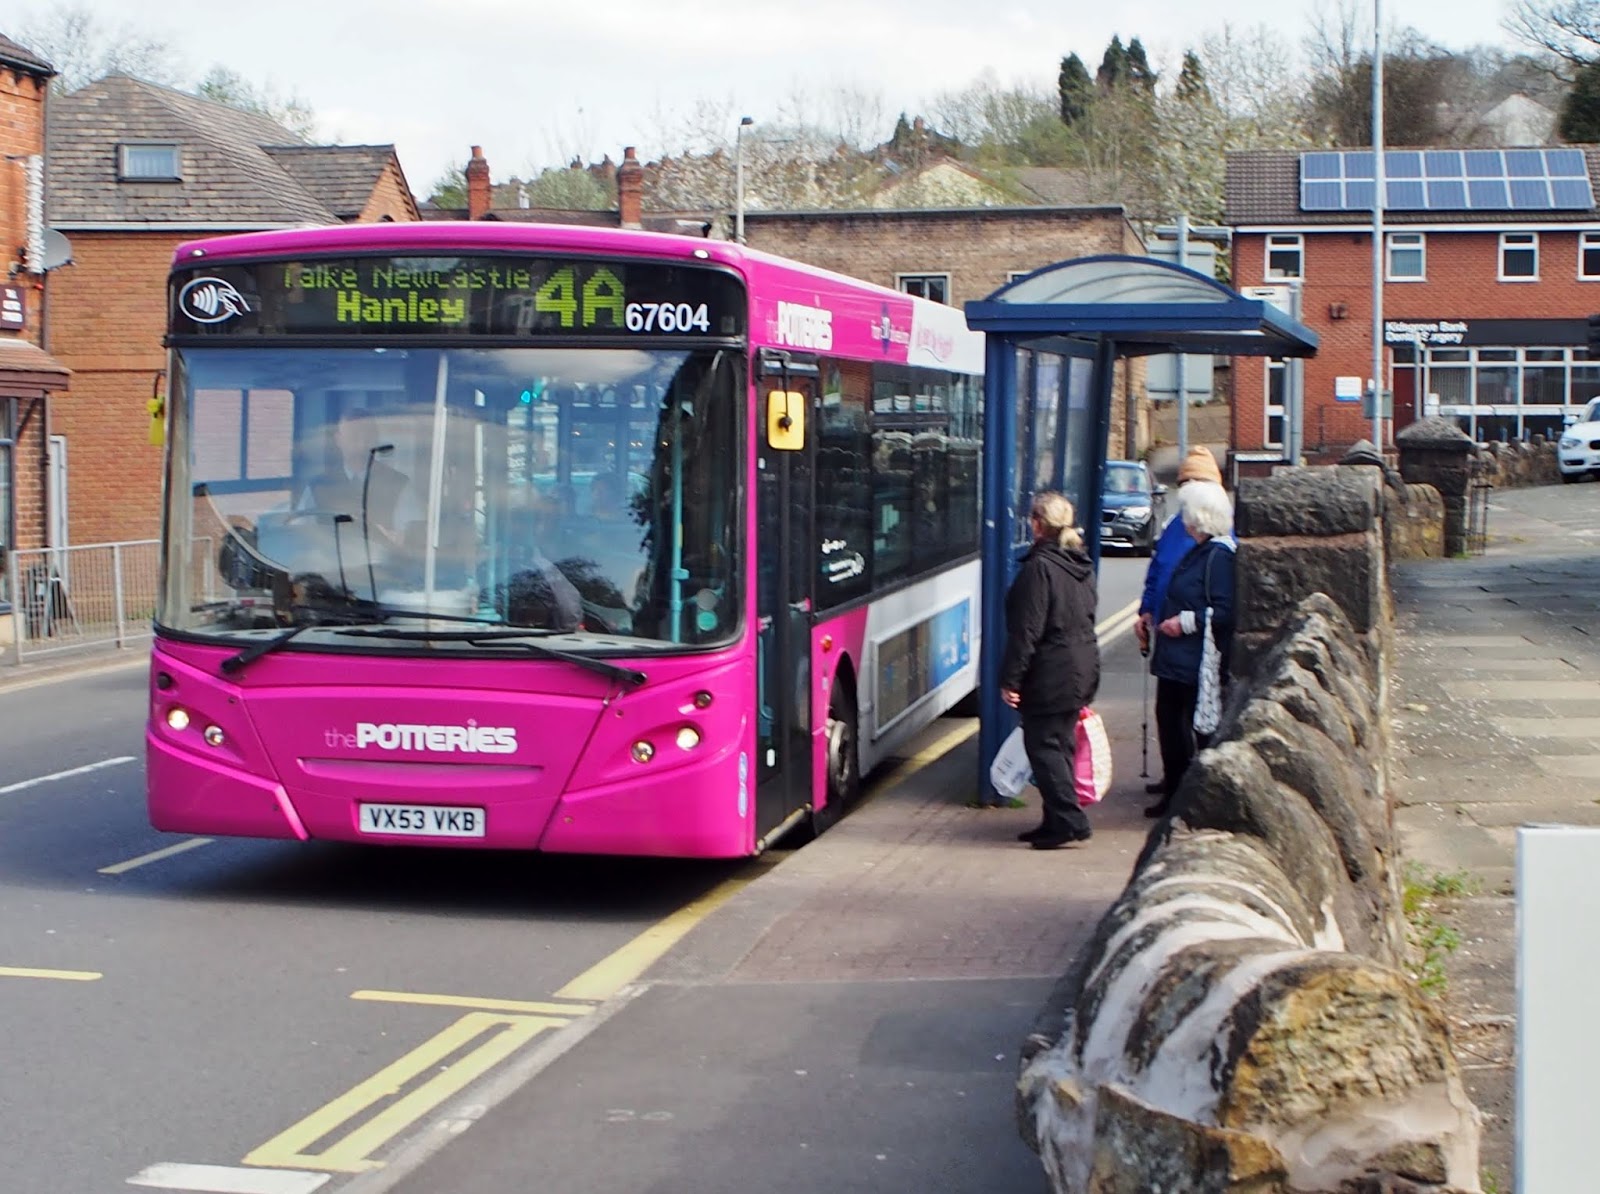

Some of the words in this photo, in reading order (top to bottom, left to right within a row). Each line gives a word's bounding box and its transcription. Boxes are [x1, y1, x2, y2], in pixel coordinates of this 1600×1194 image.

[372, 266, 531, 289] Newcastle
[336, 290, 465, 323] Hanley
[534, 264, 625, 328] 4A
[624, 302, 711, 333] 67604
[369, 807, 426, 830] VX53
[432, 810, 476, 832] VKB
